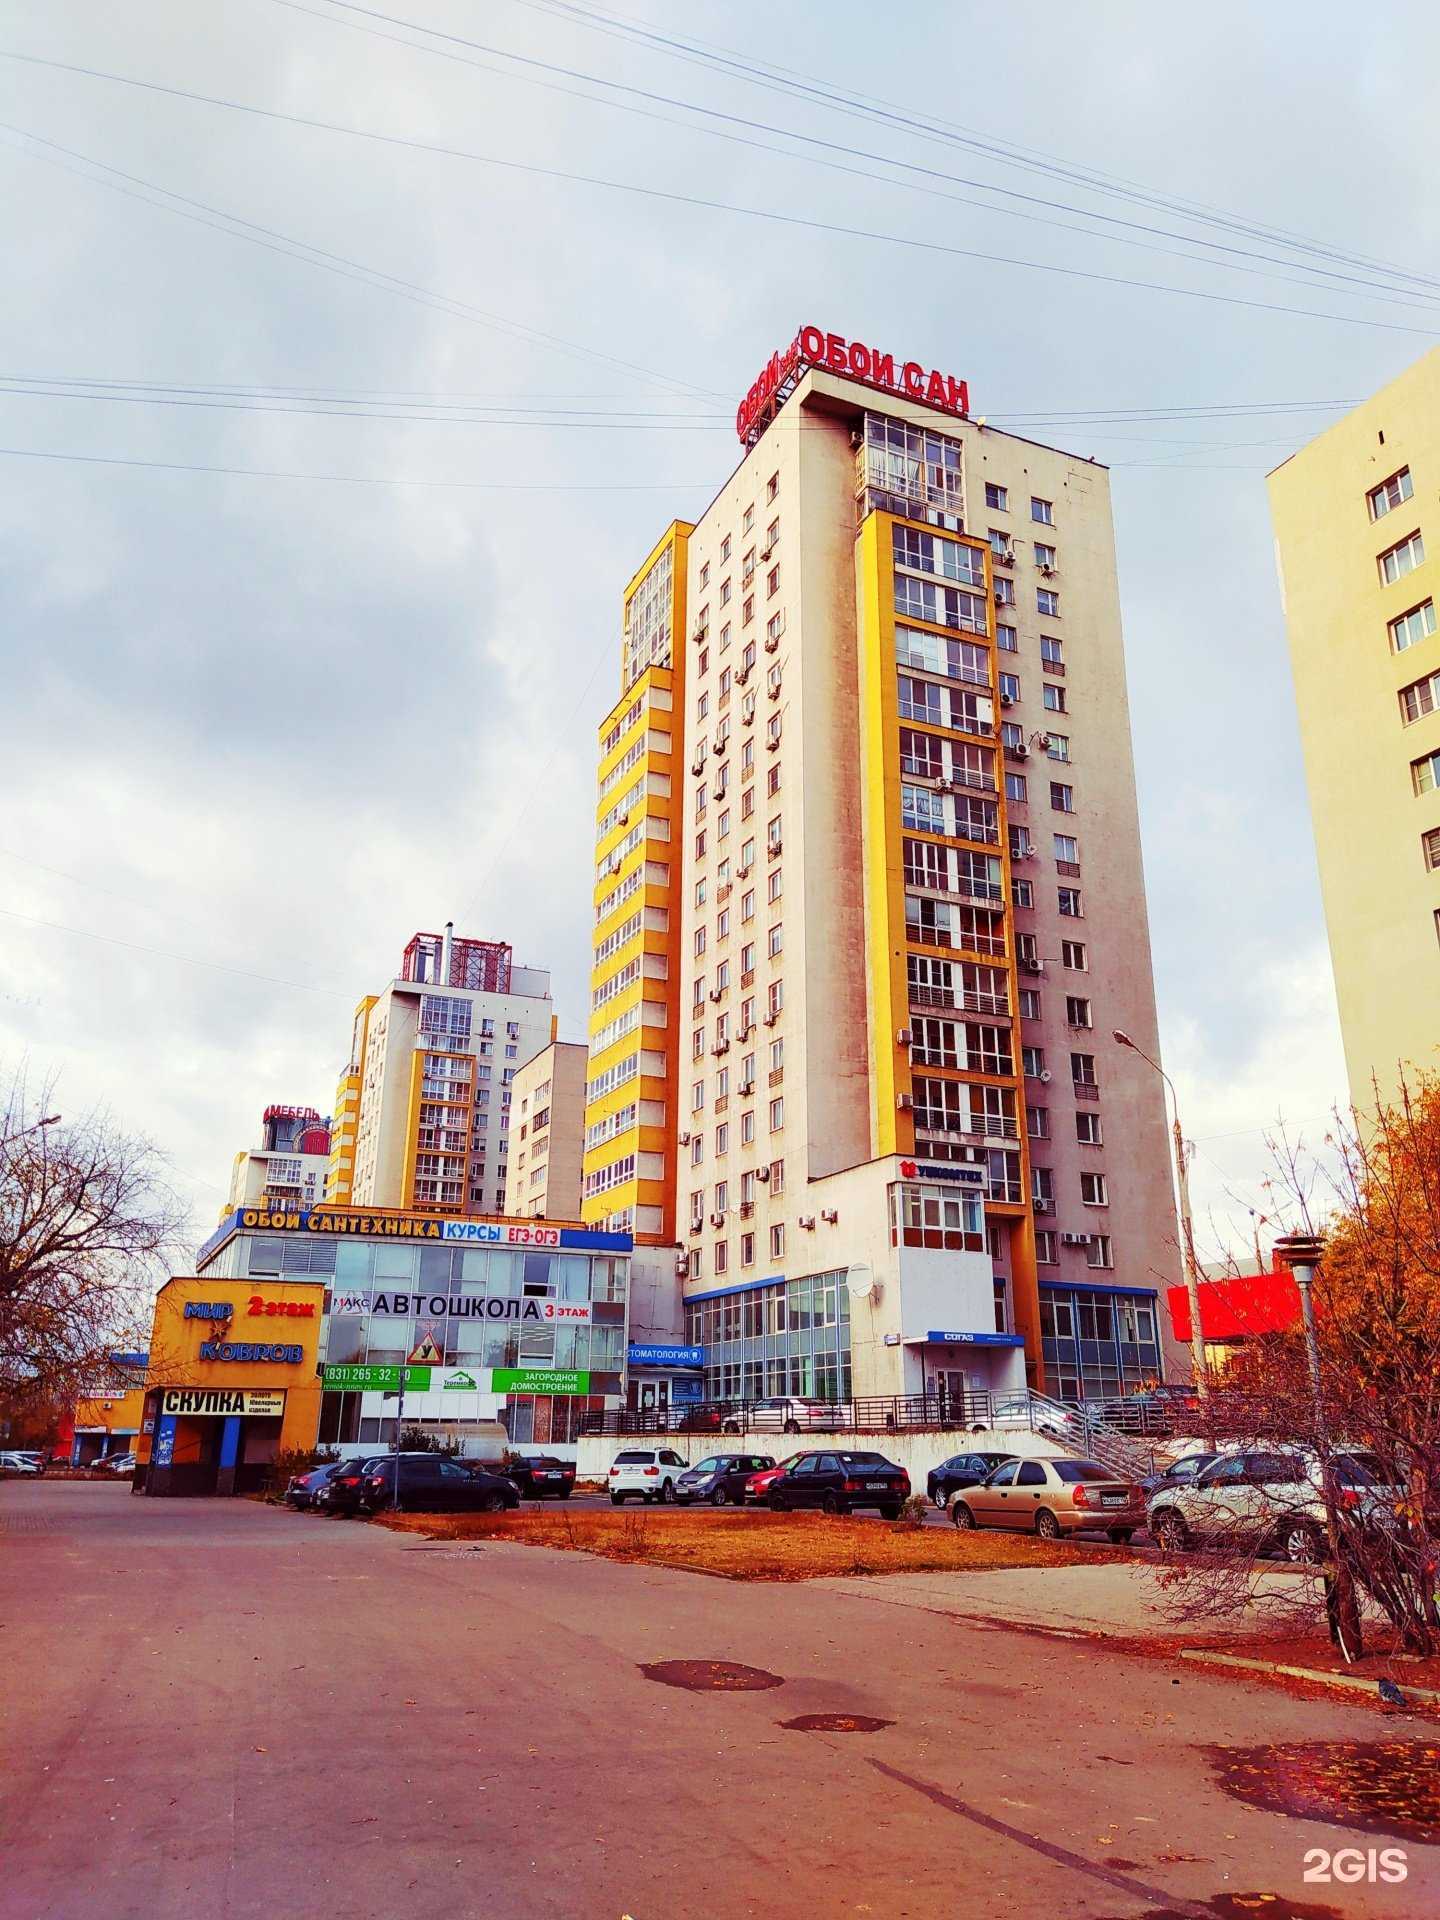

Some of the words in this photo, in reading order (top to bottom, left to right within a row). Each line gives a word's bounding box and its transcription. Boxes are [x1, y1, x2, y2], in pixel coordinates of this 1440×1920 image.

[801, 326, 894, 386] ОБОИ
[904, 361, 970, 413] САН
[270, 1104, 321, 1121] МЕБЕЛЬ
[242, 1210, 300, 1230] ОБОИ
[307, 1213, 440, 1238] САНТЕХНИКА
[447, 1223, 500, 1241] КУРСЫ
[183, 1302, 234, 1320] МИР
[372, 1294, 540, 1319] АВТОШКОЛА
[545, 1303, 555, 1318] 3
[557, 1307, 589, 1318] ЭТАЖ
[944, 1333, 974, 1342] СОГАЗ
[200, 1343, 304, 1363] КОВРОВ
[325, 1368, 350, 1381] (831)
[525, 1373, 578, 1382] ЗАГОРОДНОЕ
[510, 1382, 577, 1391] ДОМОСТРОЕНИЕ
[166, 1391, 245, 1412] СКУПКА
